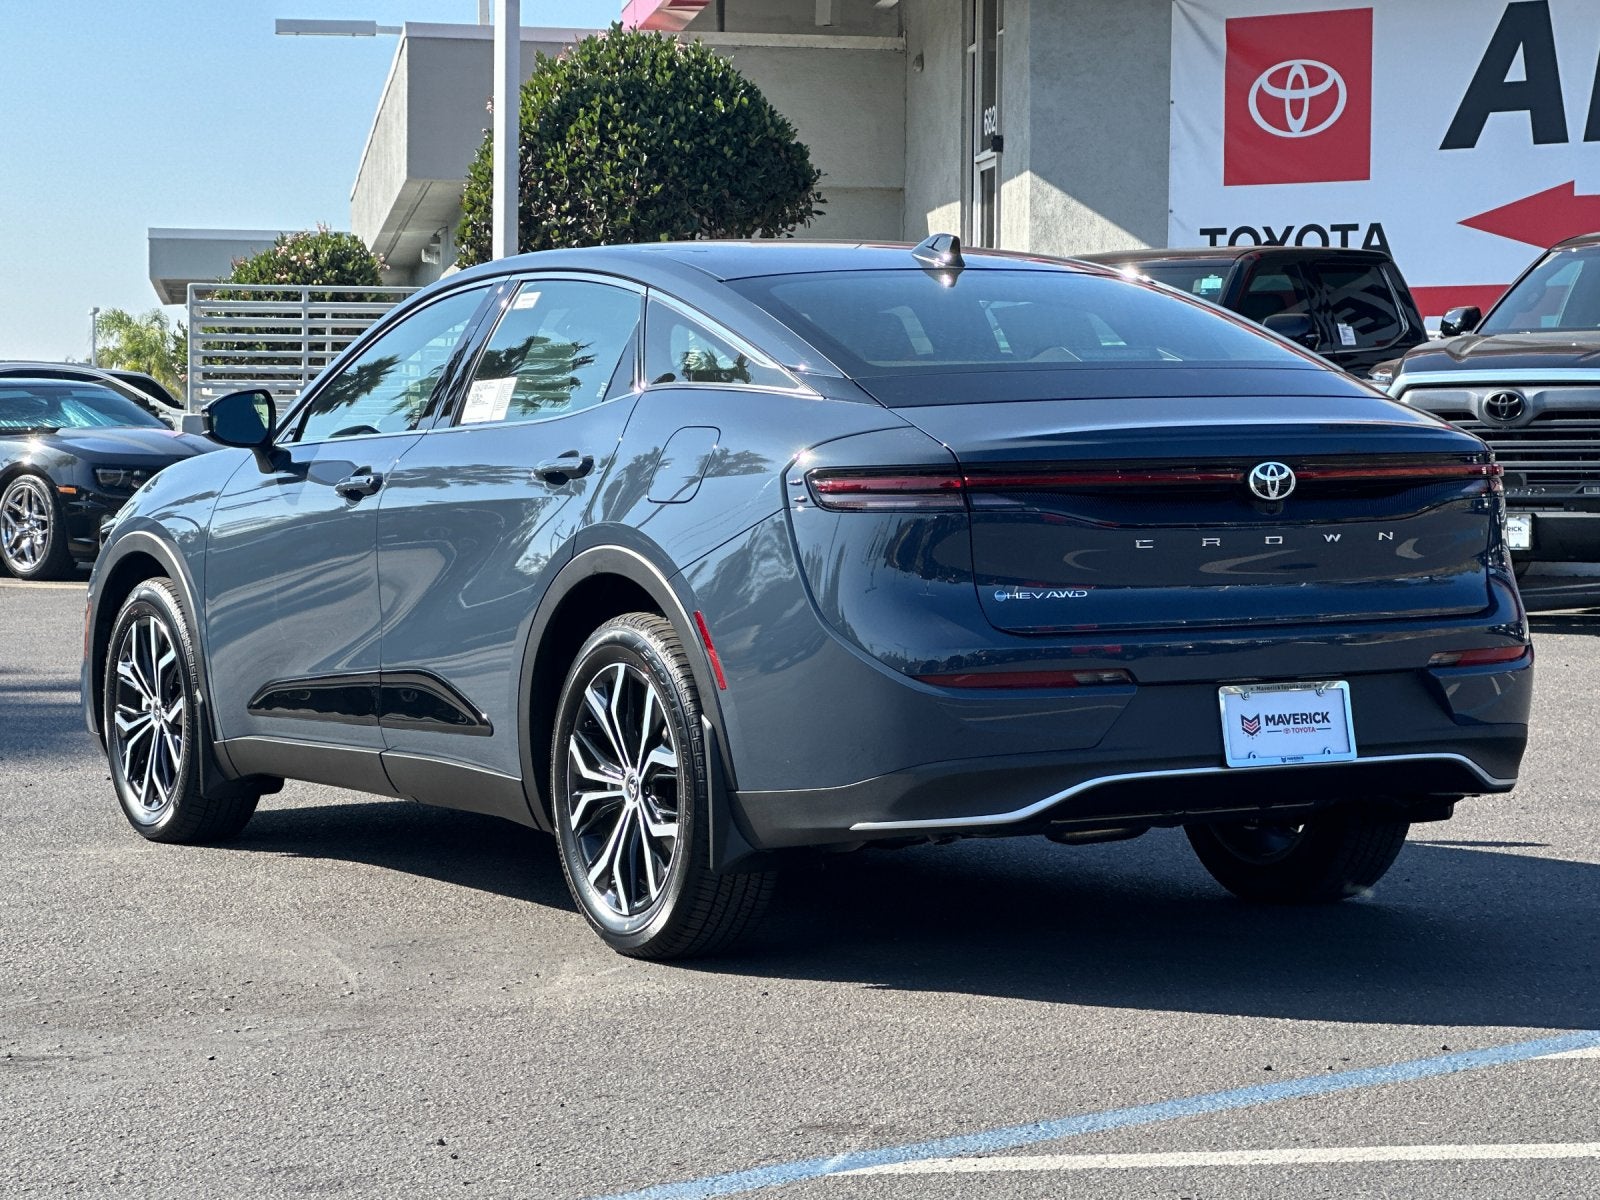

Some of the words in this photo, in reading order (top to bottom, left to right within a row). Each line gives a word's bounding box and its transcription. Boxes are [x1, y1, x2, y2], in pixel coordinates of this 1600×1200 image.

[1439, 0, 1600, 150] A
[1135, 531, 1395, 549] CROWN
[1045, 590, 1088, 599] AWD
[1265, 711, 1330, 727] MAVERICK
